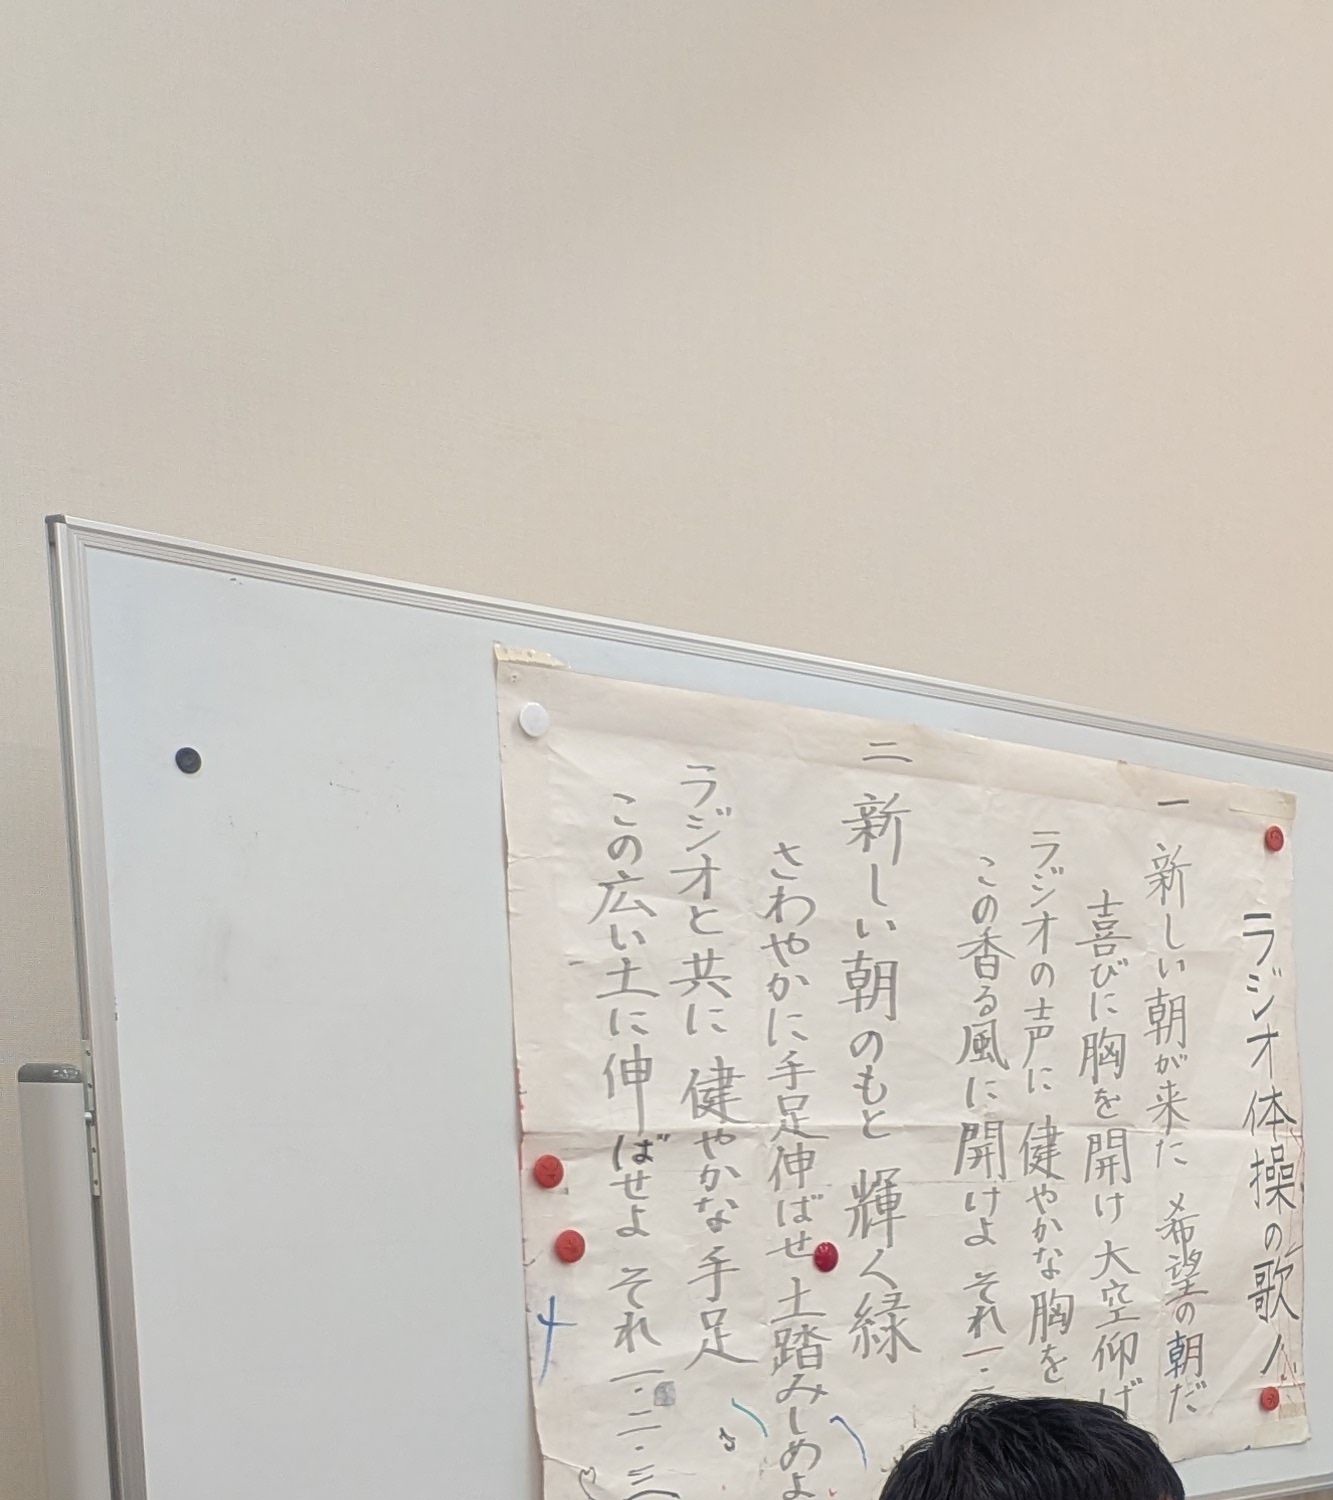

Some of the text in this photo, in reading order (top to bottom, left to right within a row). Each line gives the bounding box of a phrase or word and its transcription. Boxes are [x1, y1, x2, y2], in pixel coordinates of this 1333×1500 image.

[587, 792, 671, 1238] この広い土に伸ばせよ
[668, 764, 759, 1371] ラジオと共に 健やかな手足
[759, 841, 829, 1259] さわやかに手足伸ばせ
[837, 792, 912, 1140] 新しい朝のもと
[953, 855, 1016, 1247] この香る風に開けよ
[1018, 830, 1075, 1385] ラジオの声に 健やかな胸を
[1075, 888, 1132, 1224] 喜びに胸を開け
[1143, 842, 1193, 1169] 新しい朝が来た
[843, 1166, 923, 1365] 輝く緑
[1155, 1191, 1209, 1424] 希望の朝だ
